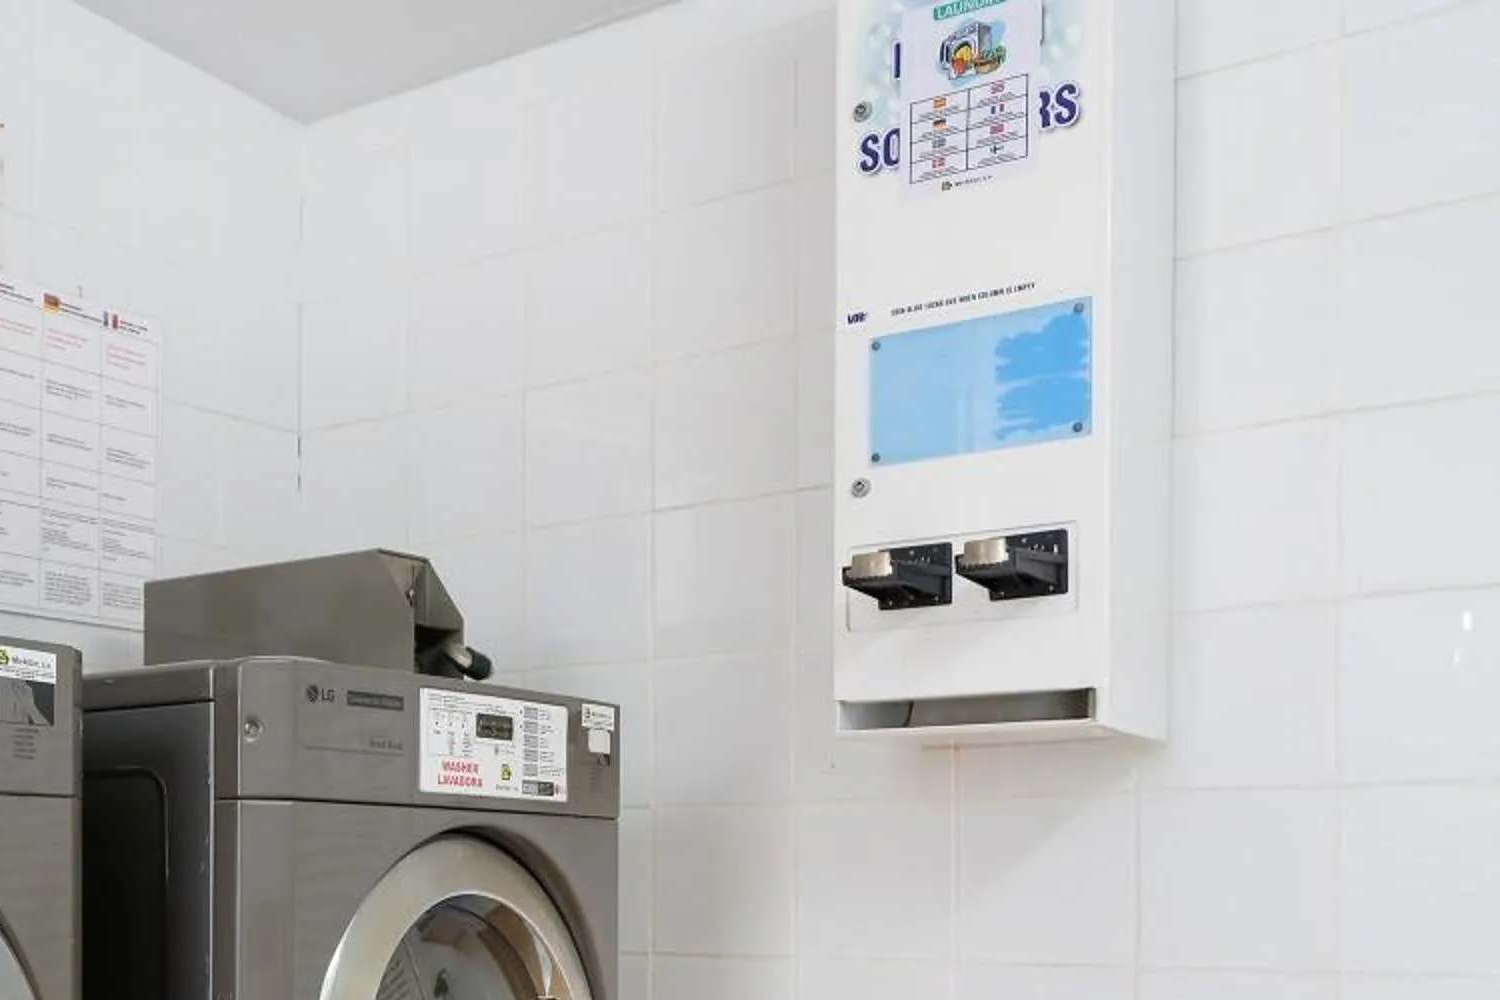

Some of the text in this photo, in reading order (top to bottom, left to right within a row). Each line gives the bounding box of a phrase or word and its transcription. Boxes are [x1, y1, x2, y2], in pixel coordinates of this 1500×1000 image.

[321, 688, 336, 703] LG
[442, 759, 480, 774] WASHER
[436, 773, 484, 789] LAVADORA
